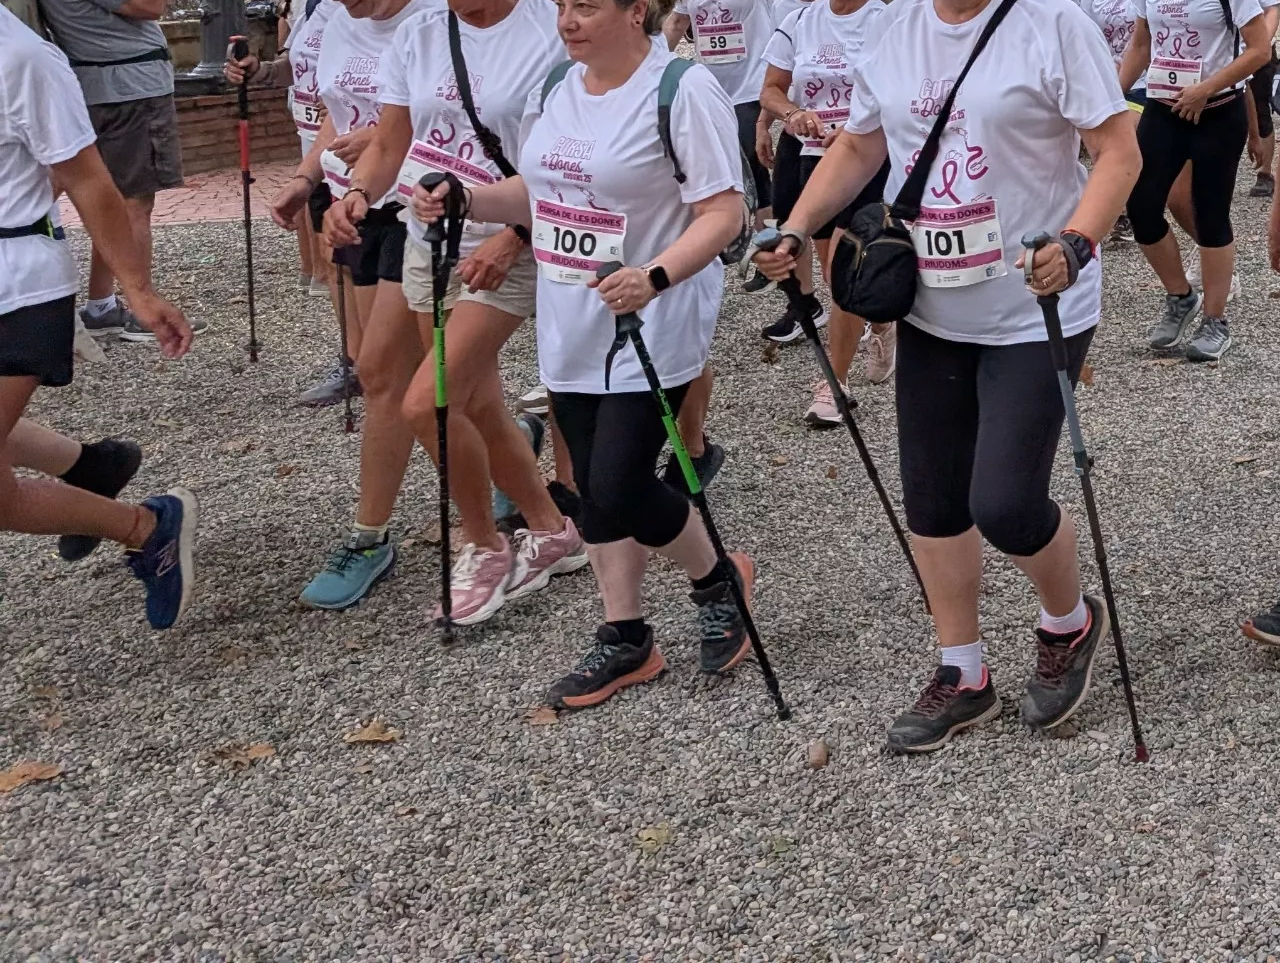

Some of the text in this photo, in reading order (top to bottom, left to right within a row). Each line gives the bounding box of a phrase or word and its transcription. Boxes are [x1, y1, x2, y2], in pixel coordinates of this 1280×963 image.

[709, 36, 727, 49] 59
[342, 56, 380, 74] CURSA
[341, 71, 372, 87] Dones
[1168, 71, 1177, 85] 9
[305, 106, 320, 123] 57
[550, 136, 597, 160] CURSA
[415, 149, 441, 163] CURSA
[442, 158, 454, 167] DE
[455, 161, 469, 173] LES
[549, 154, 583, 173] Dones
[539, 205, 622, 227] CURSA DE LES DONES
[940, 212, 957, 221] LES
[957, 206, 991, 219] DONES
[553, 226, 597, 257] 100
[925, 230, 966, 256] 101
[551, 255, 589, 269] RIUDOMS
[925, 259, 968, 269] RIUDOMS
